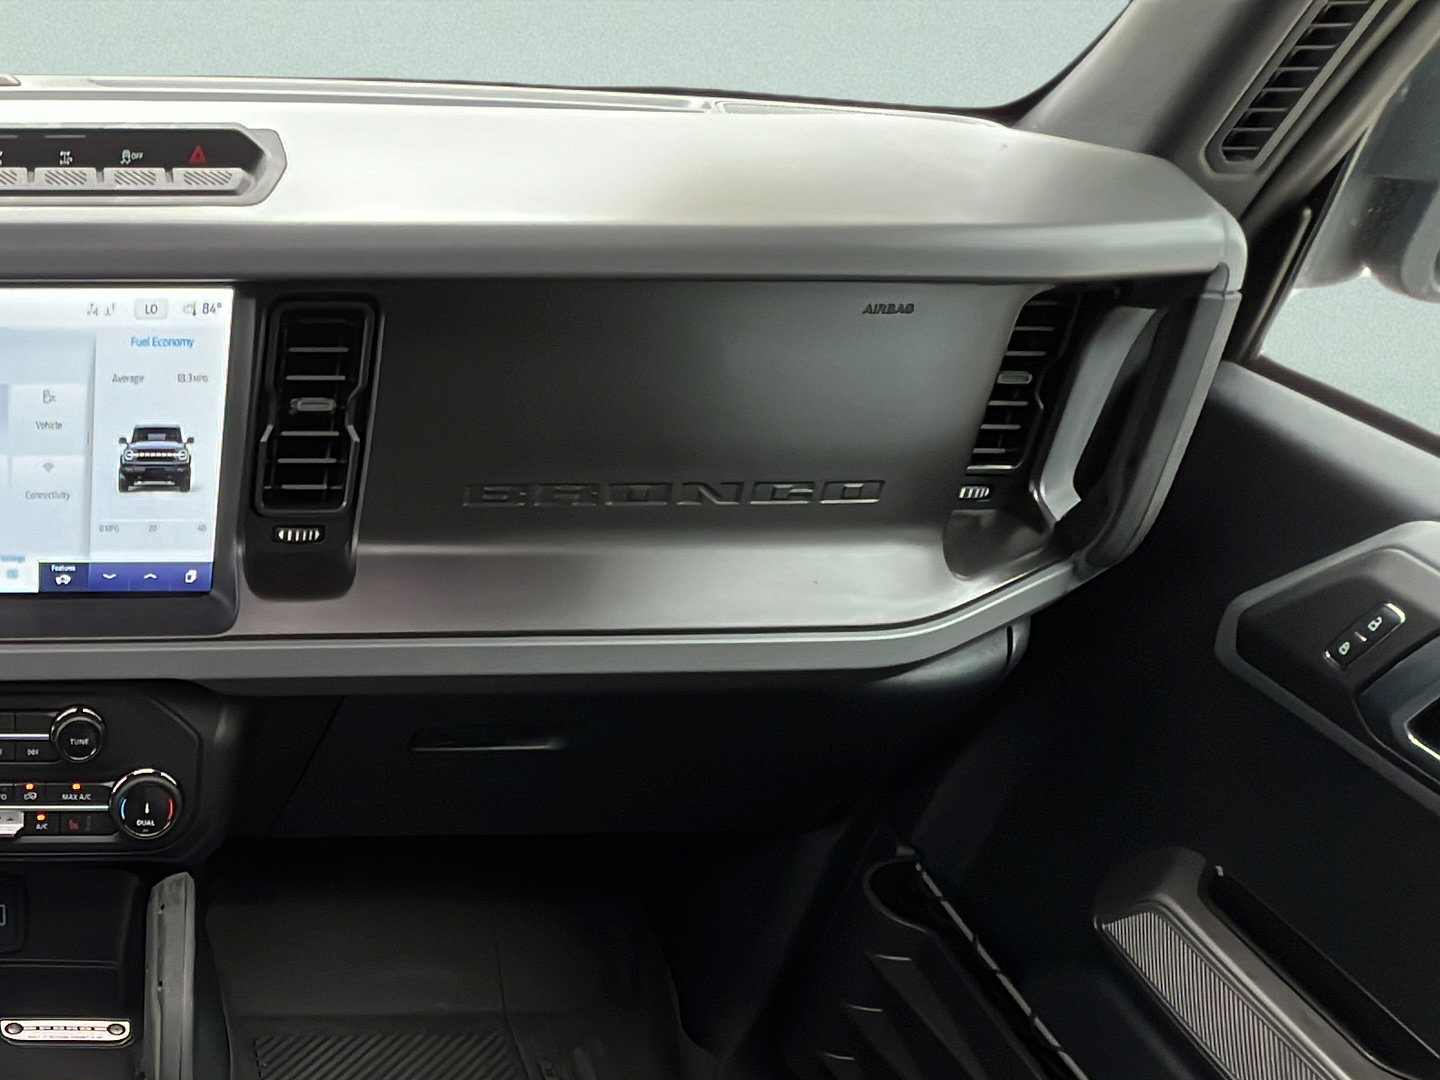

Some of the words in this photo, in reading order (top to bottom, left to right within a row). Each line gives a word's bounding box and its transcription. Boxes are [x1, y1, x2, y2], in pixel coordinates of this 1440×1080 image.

[131, 152, 143, 160] OFF
[145, 304, 158, 314] LO
[202, 302, 222, 314] 84°
[862, 303, 915, 314] AIRBAG
[131, 336, 150, 347] Fuel
[152, 336, 194, 349] Economy
[112, 373, 144, 385] Average
[36, 421, 62, 430] Vehicle
[25, 491, 70, 501] Connectivity
[461, 480, 885, 508] BRONCO
[51, 564, 76, 572] Features
[79, 793, 92, 801] A/C
[136, 819, 155, 827] DUAL
